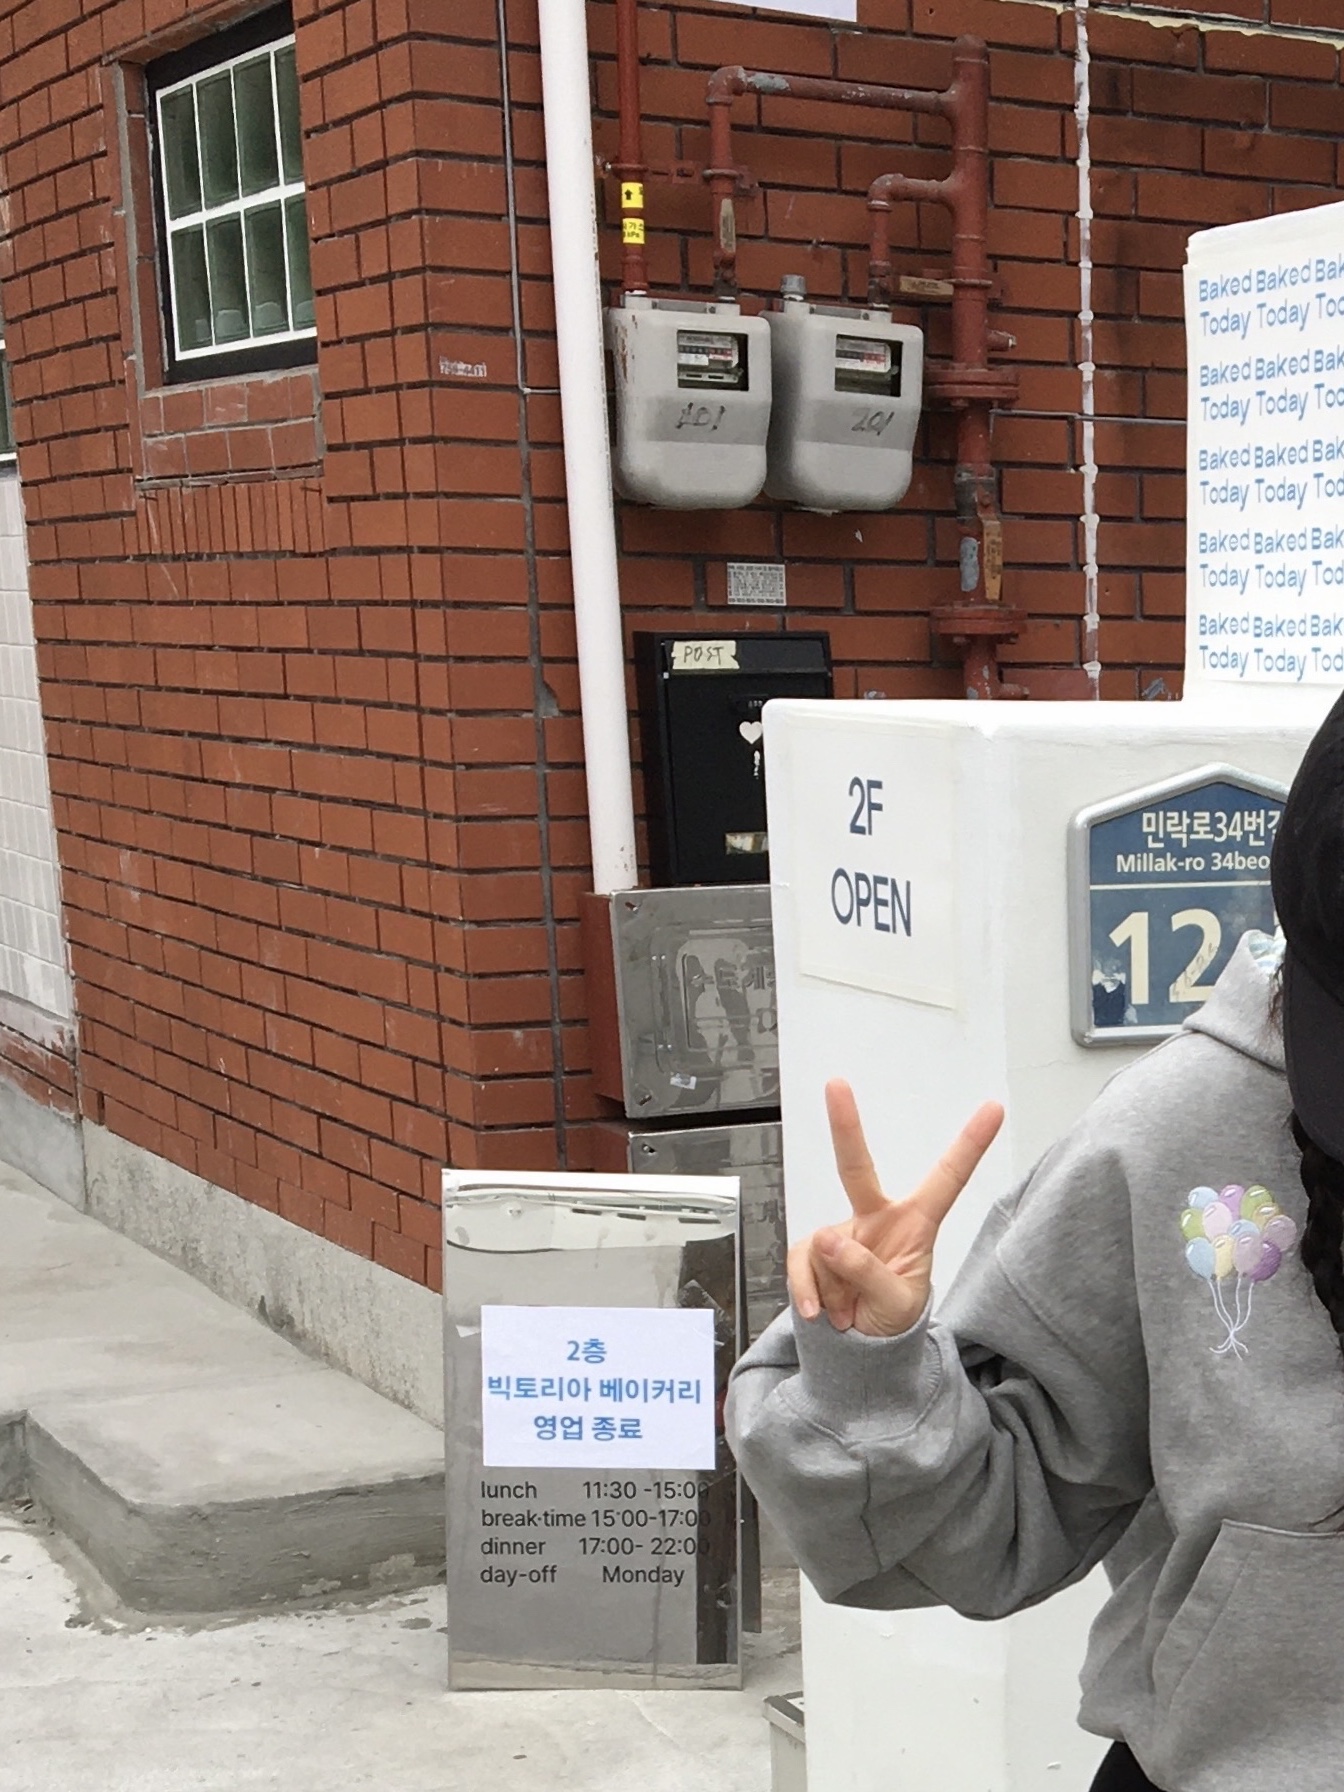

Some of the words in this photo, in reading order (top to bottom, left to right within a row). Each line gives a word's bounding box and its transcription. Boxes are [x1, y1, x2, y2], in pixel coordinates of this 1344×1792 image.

[1199, 269, 1251, 302] Baked
[1256, 258, 1311, 293] Baked
[1200, 307, 1251, 340] Today
[1256, 298, 1310, 332] Today
[1200, 356, 1251, 387] Baked
[1255, 348, 1310, 380] Baked
[851, 406, 895, 436] 201
[1200, 393, 1250, 426] Today
[1256, 387, 1309, 421] Today
[1199, 442, 1250, 471] Baked
[1254, 439, 1309, 469] Baked
[1200, 478, 1250, 512] Today
[1254, 475, 1308, 510] Today
[1199, 527, 1250, 554] Baked
[1254, 526, 1307, 555] Baked
[1199, 562, 1250, 595] Today
[1255, 562, 1307, 597] Today
[1199, 611, 1250, 636] Baked
[1253, 613, 1307, 638] Baked
[684, 645, 725, 666] POST
[1199, 645, 1249, 678] Today
[1254, 647, 1307, 682] Today
[848, 776, 883, 836] 2F
[1116, 853, 1205, 873] Millak-ro
[831, 867, 912, 937] OPEN
[1109, 908, 1279, 1005] 12
[567, 1338, 607, 1364] 2층
[488, 1376, 592, 1402] 빅토리아
[599, 1378, 701, 1404] 베이커리
[534, 1415, 584, 1441] 영업
[591, 1416, 643, 1442] 종료
[481, 1481, 538, 1499] lunch
[583, 1481, 637, 1499] 11:30
[480, 1537, 546, 1556] dinner
[480, 1565, 557, 1587] day-off
[603, 1565, 685, 1587] Monday
